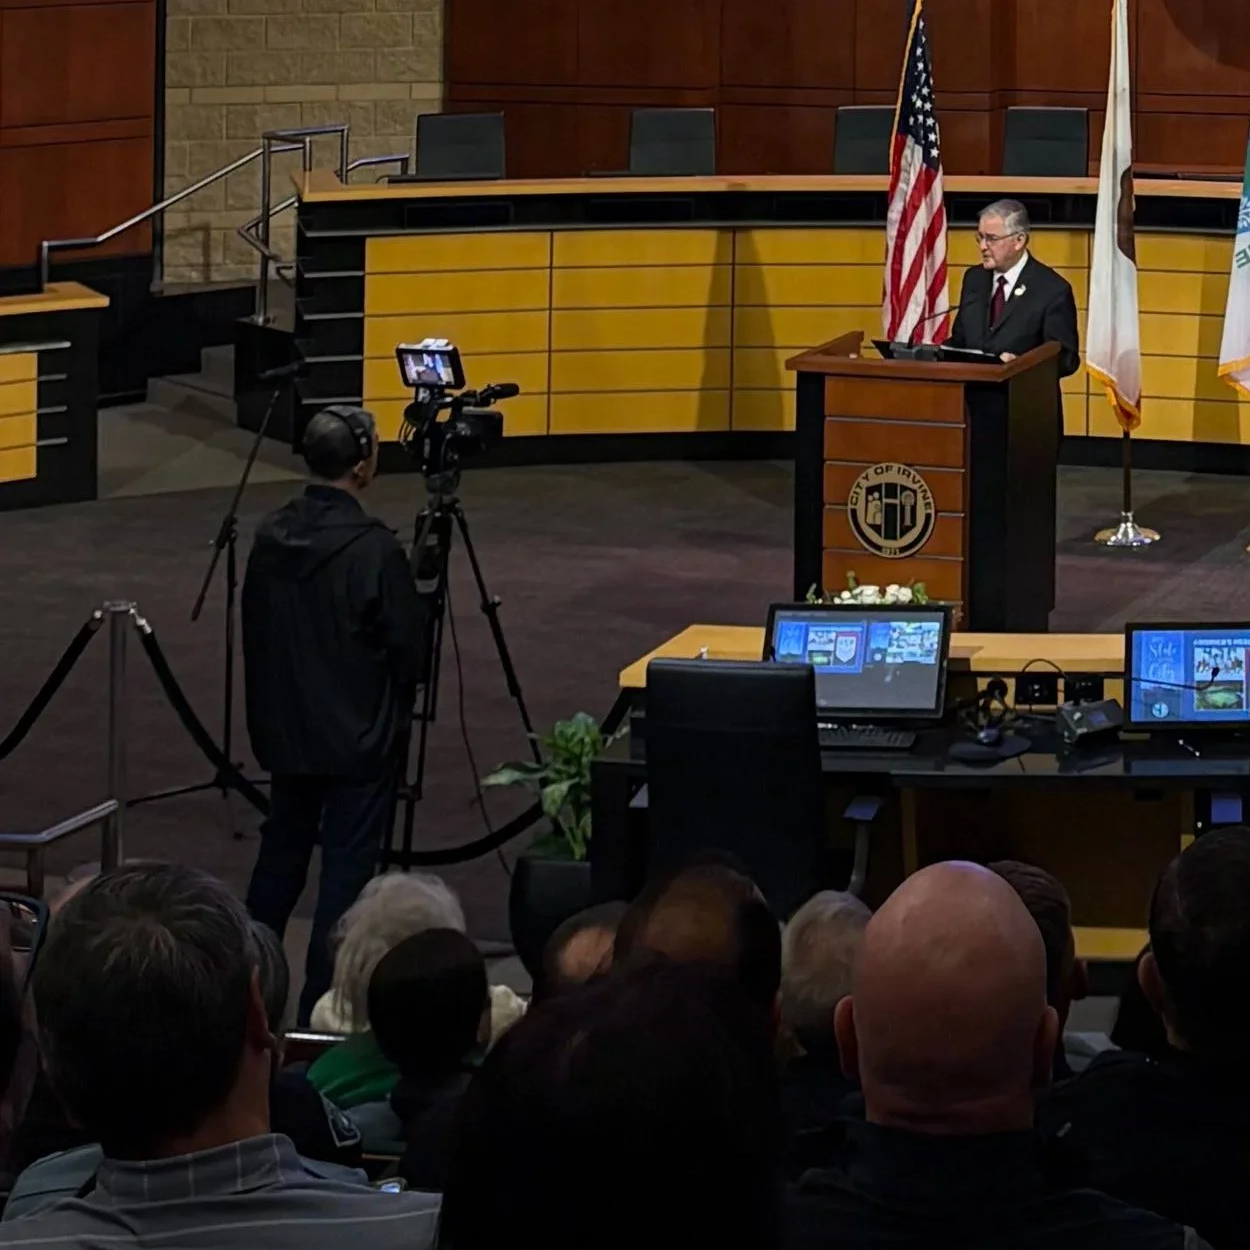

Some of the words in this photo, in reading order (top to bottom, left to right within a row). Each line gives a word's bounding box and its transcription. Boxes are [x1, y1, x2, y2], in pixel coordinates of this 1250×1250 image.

[849, 473, 871, 506] CITY
[873, 465, 895, 476] OF
[897, 466, 932, 512] IRVINE
